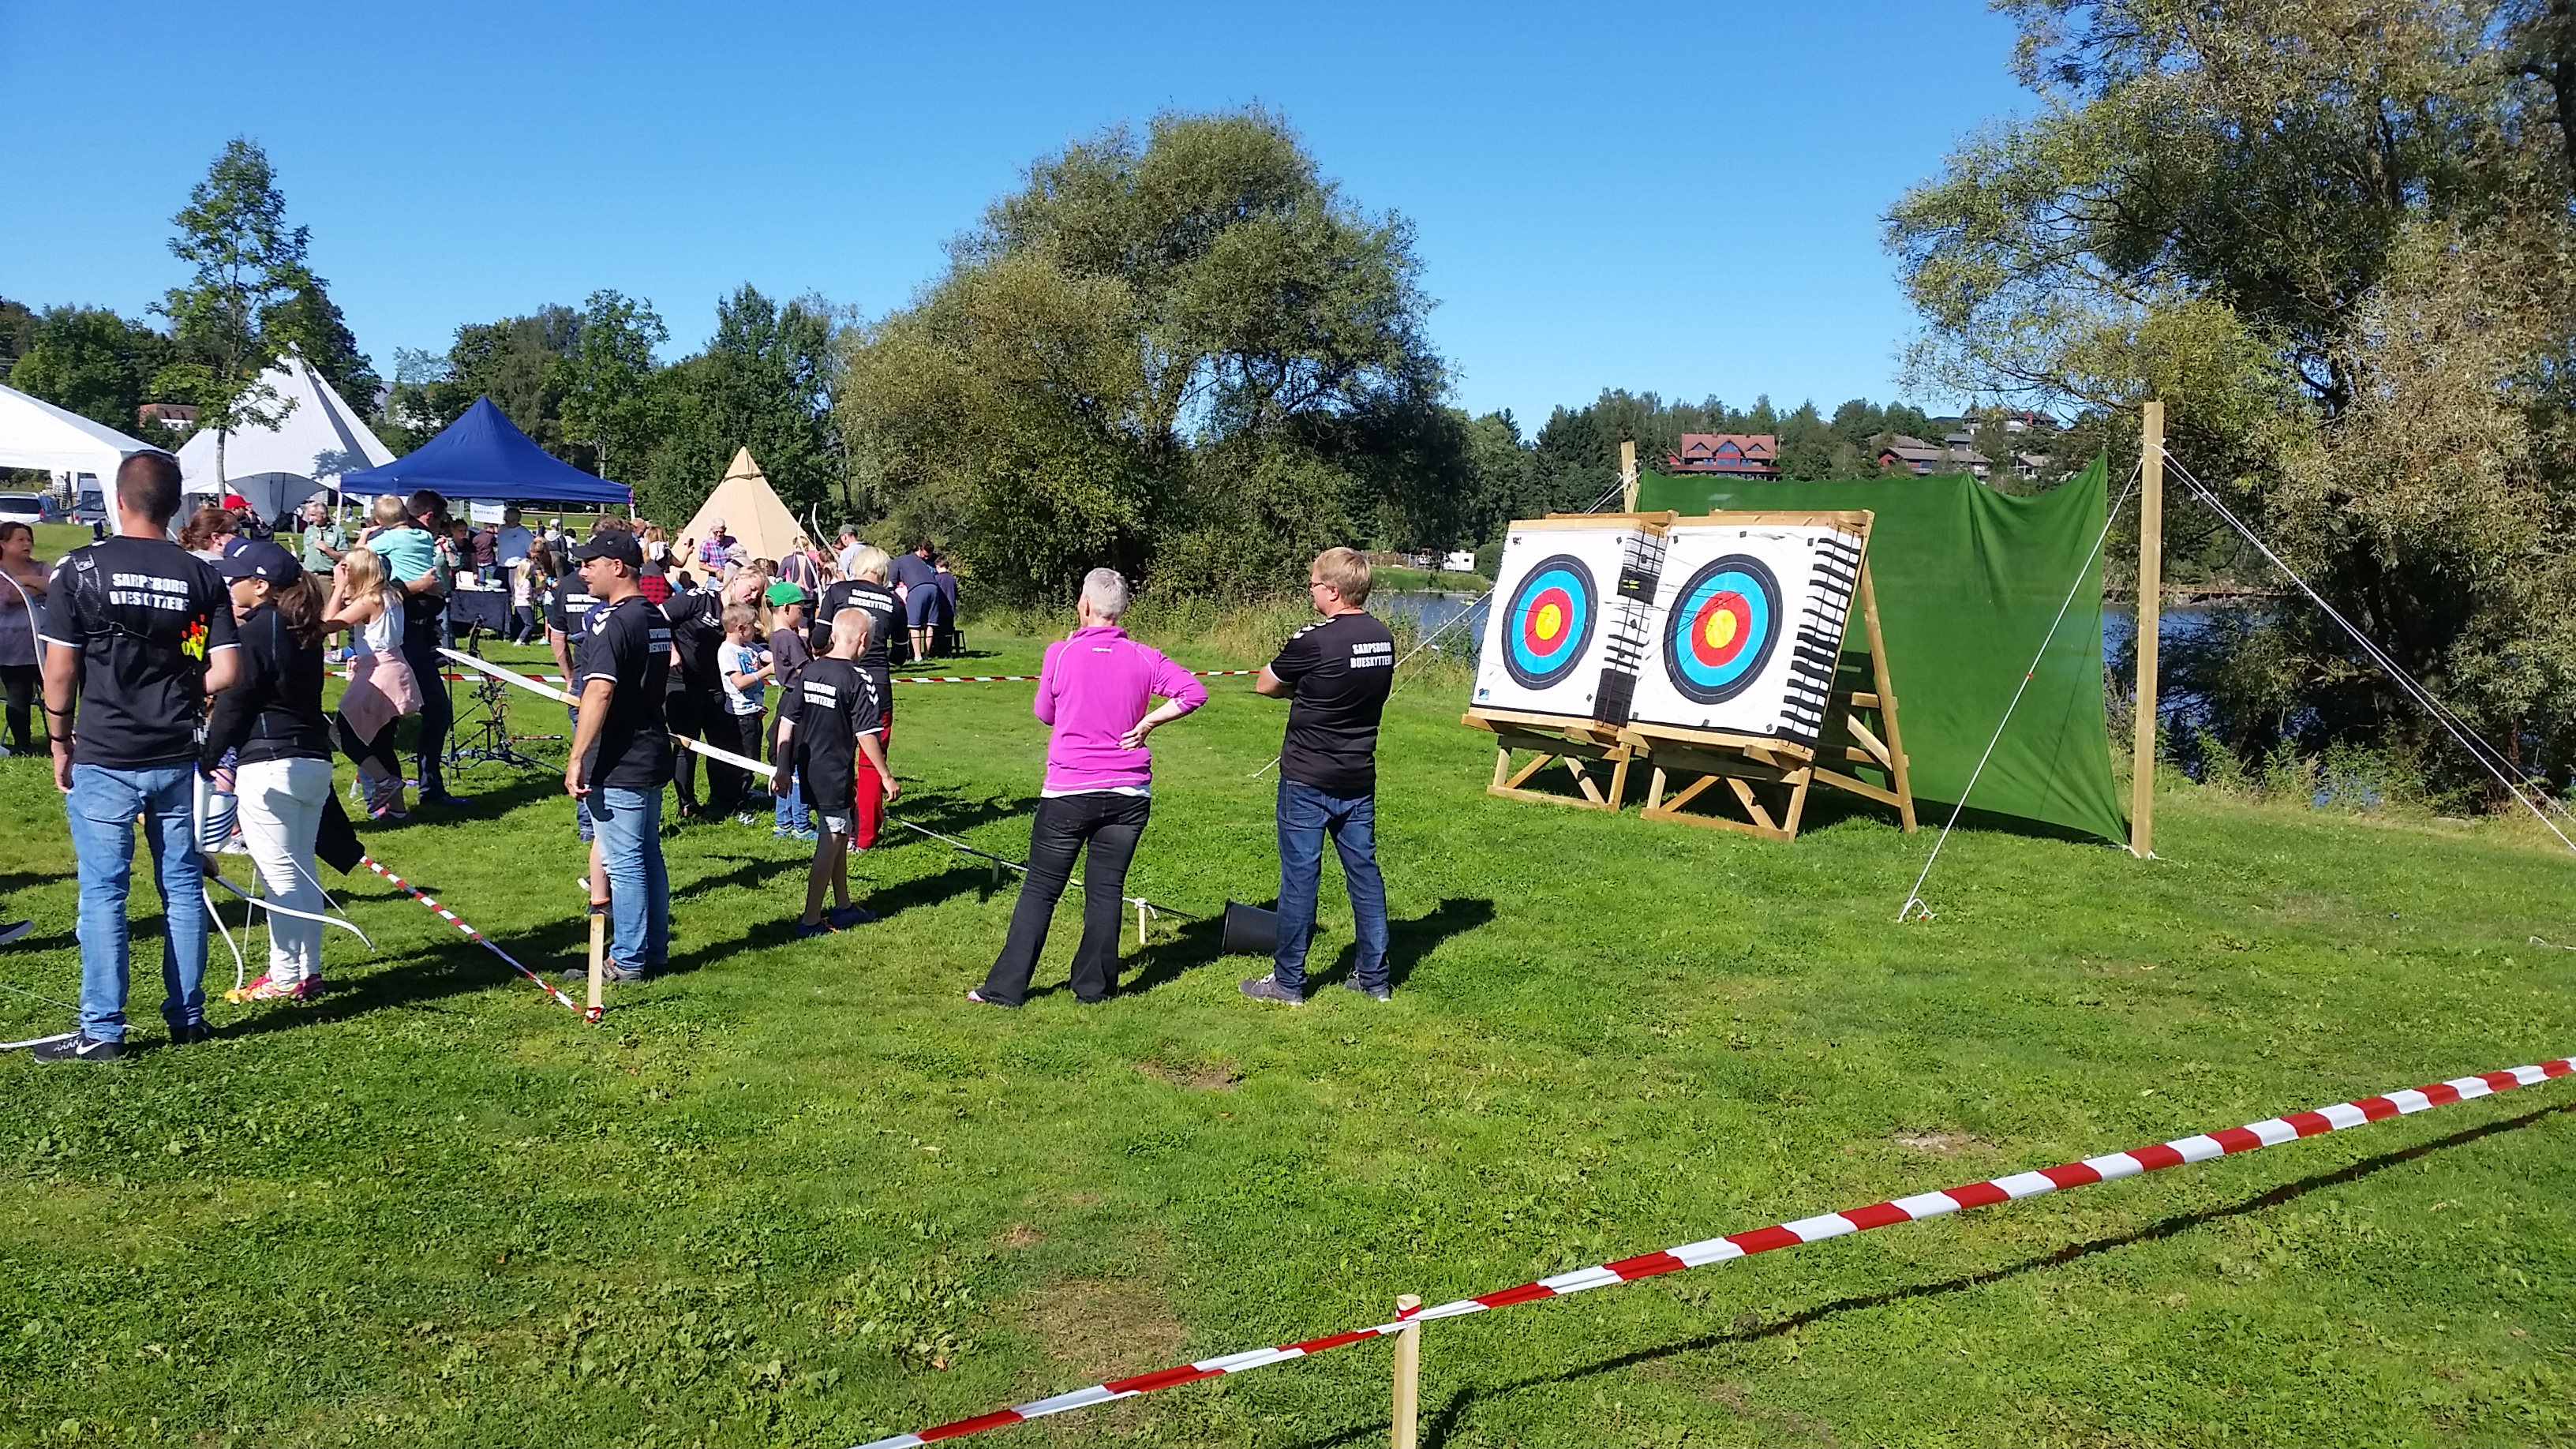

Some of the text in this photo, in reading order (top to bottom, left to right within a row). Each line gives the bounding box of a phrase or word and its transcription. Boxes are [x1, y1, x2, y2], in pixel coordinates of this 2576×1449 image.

[112, 573, 189, 594] SARPSBORG
[1352, 642, 1391, 654] SARPSBORG
[1350, 655, 1392, 668] BUESKYTTER
